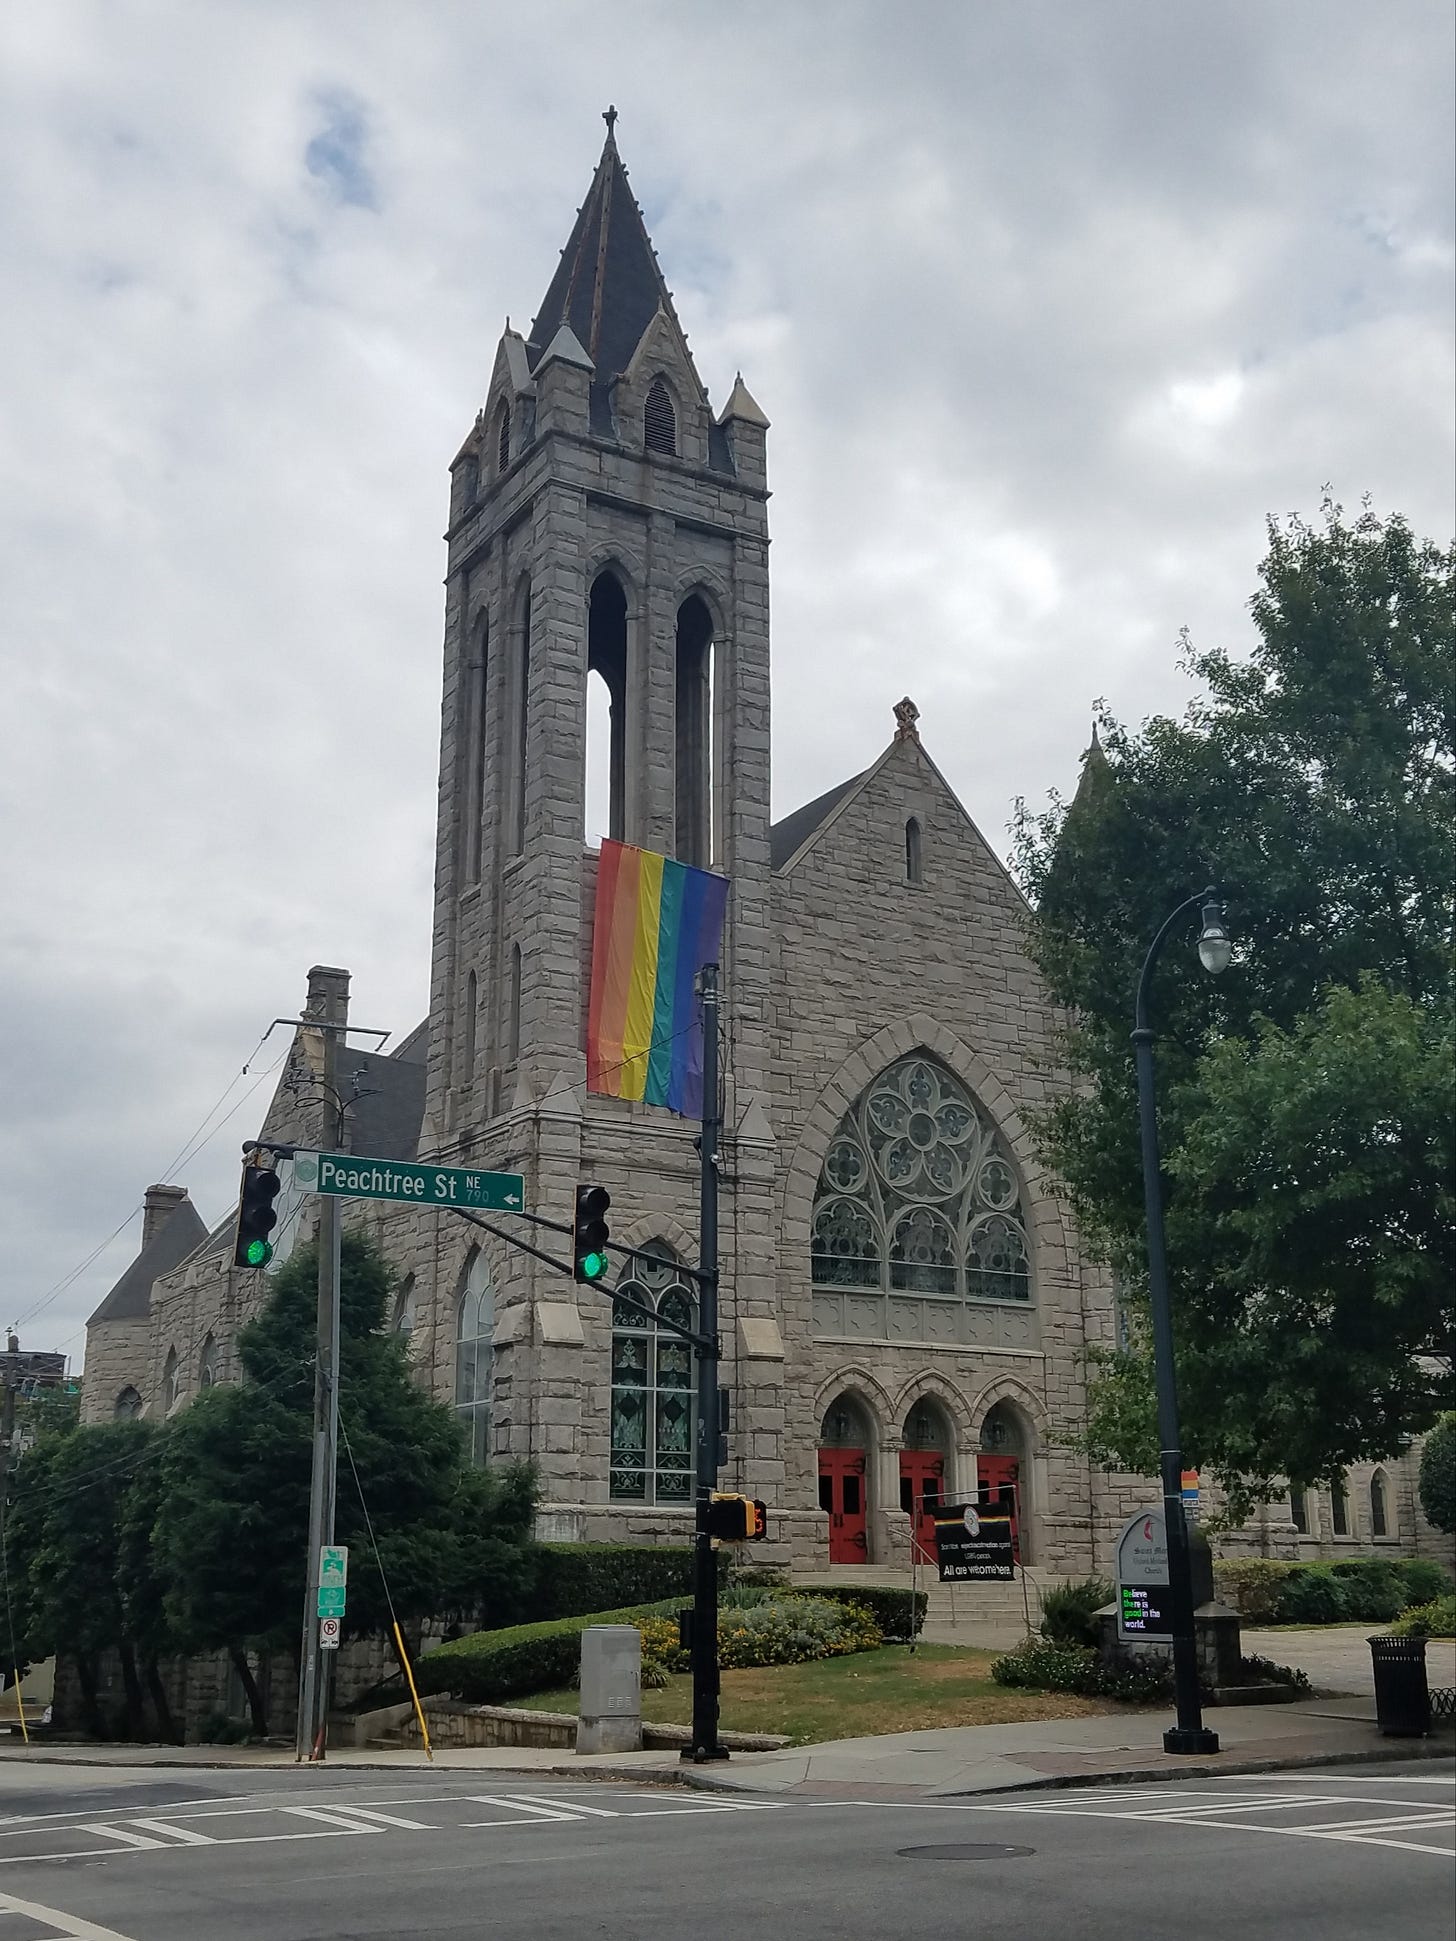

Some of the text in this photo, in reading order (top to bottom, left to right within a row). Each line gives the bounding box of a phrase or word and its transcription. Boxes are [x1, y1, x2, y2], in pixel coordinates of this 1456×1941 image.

[321, 1162, 481, 1200] Peachtree St NE
[466, 1190, 489, 1203] 790
[944, 1565, 955, 1576] All
[955, 1565, 968, 1575] are
[1123, 1589, 1147, 1598] Believe
[1123, 1600, 1148, 1608] there is
[1124, 1608, 1160, 1619] good in the
[1124, 1619, 1146, 1629] world.
